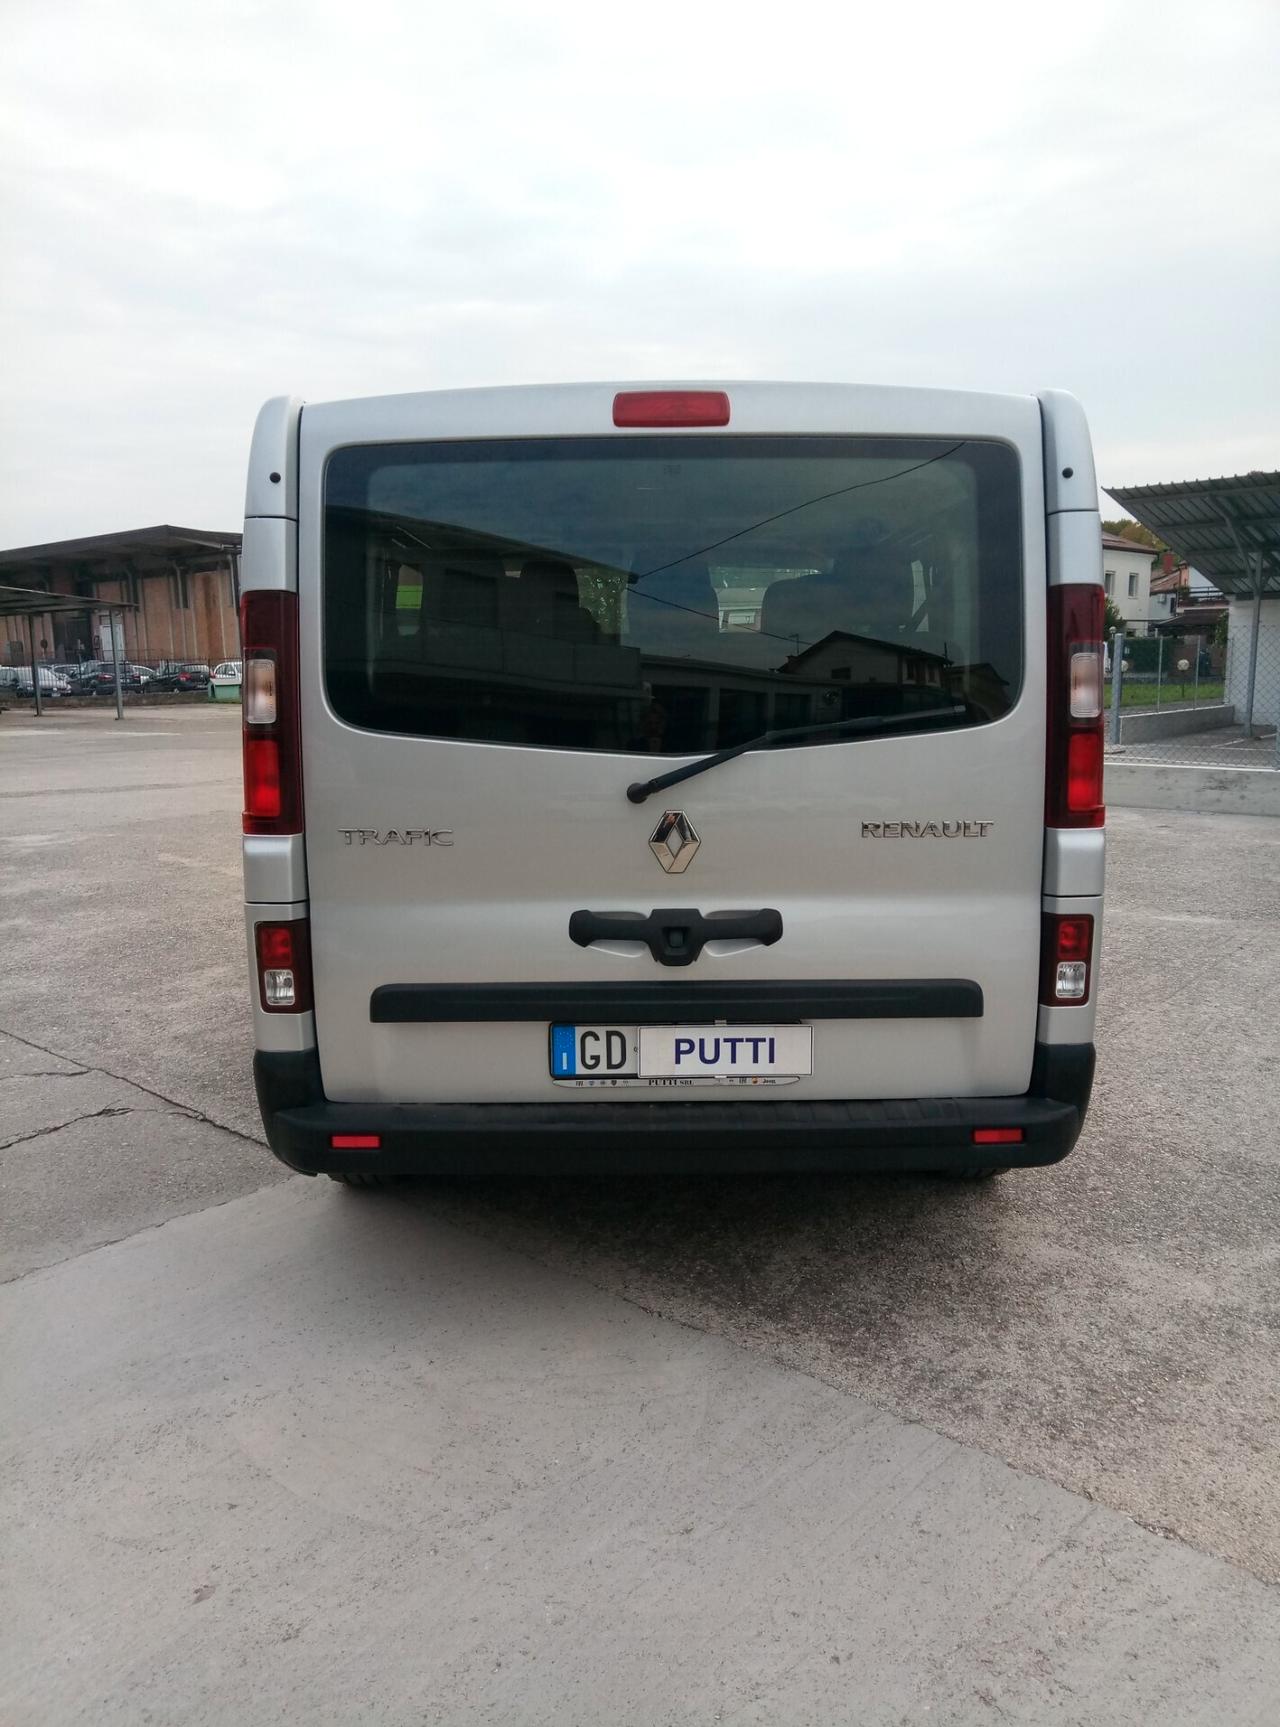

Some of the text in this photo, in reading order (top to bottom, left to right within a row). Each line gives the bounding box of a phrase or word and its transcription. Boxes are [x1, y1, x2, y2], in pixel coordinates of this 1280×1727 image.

[338, 828, 454, 846] TRAFIC
[861, 820, 995, 839] RENAULT
[580, 1030, 627, 1070] GD
[674, 1037, 775, 1065] PUTTI
[648, 1078, 678, 1086] PUTTI
